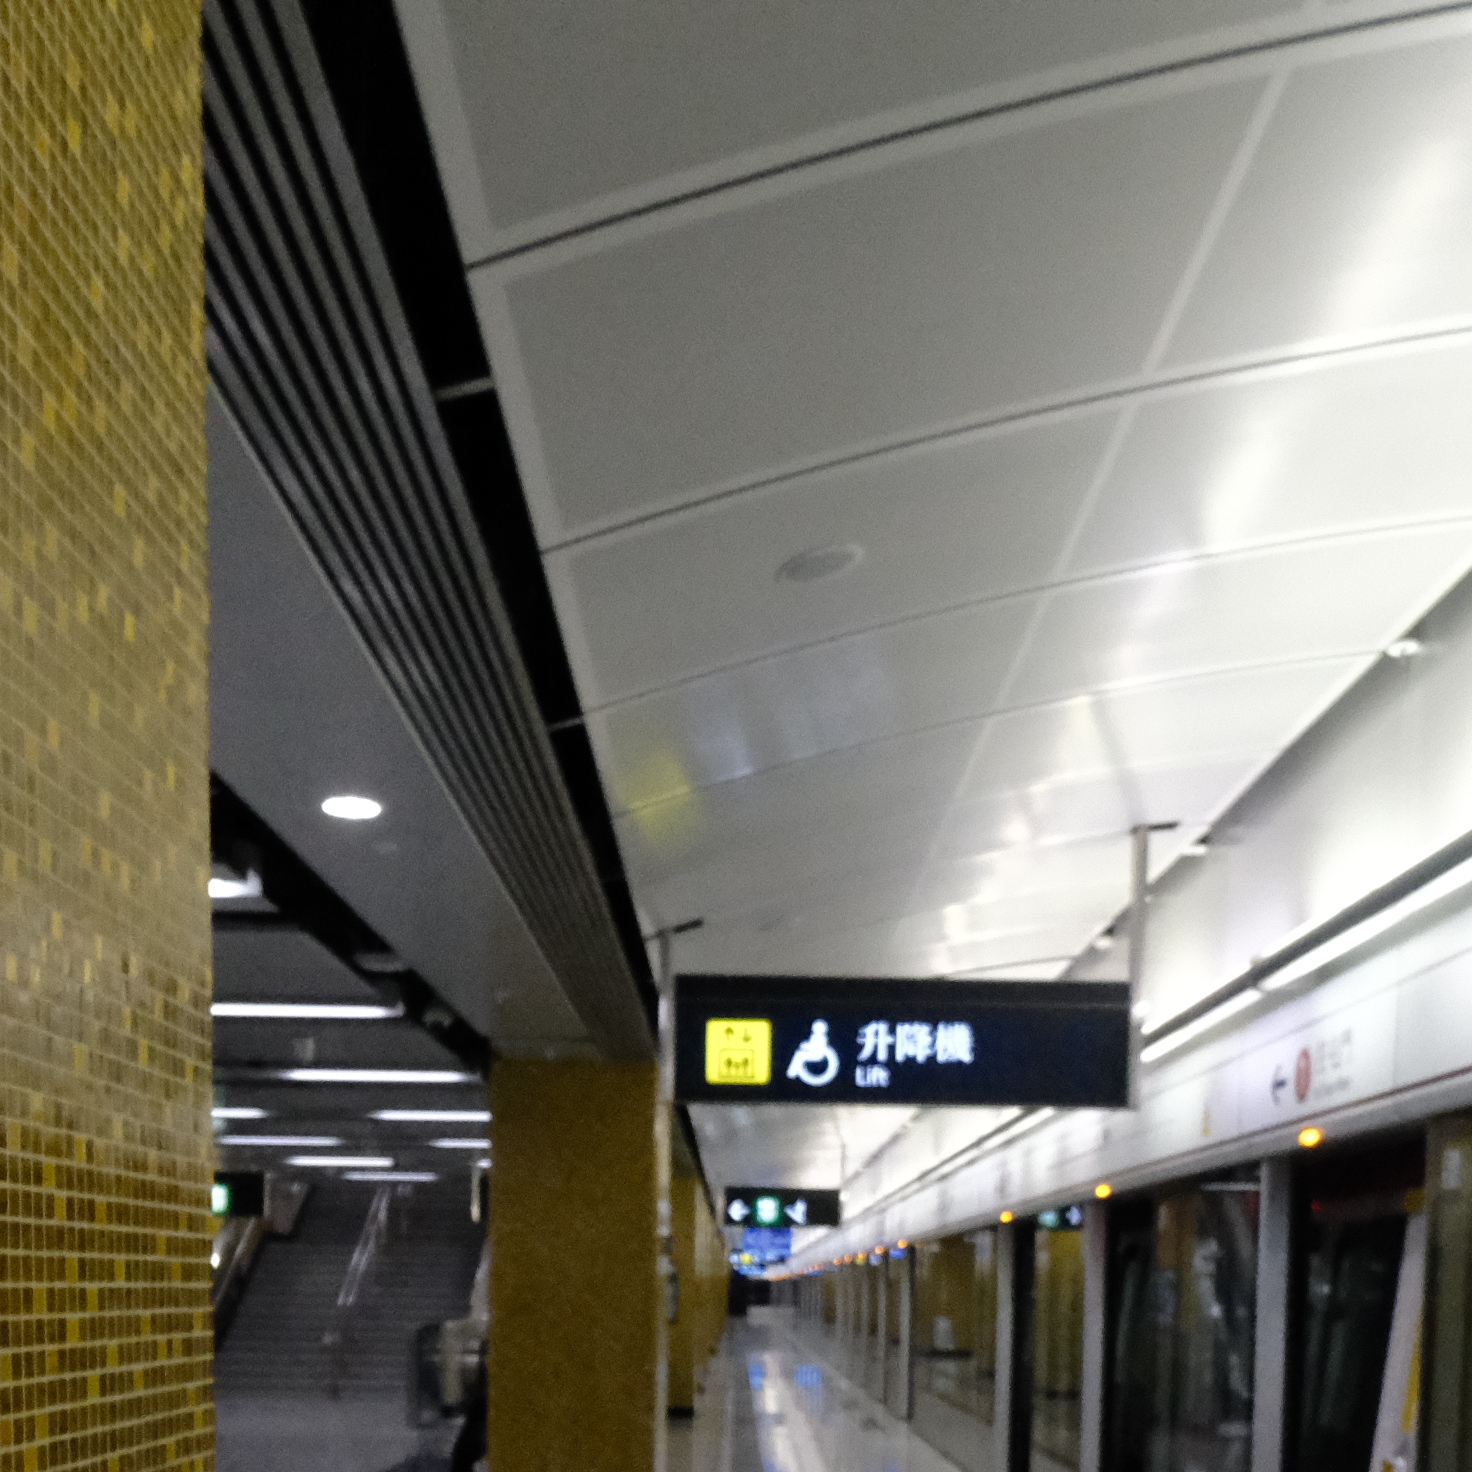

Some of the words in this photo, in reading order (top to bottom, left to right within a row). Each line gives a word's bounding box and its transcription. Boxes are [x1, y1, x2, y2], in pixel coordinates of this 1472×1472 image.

[856, 1020, 974, 1064] 升降機
[855, 1064, 891, 1088] Lift
